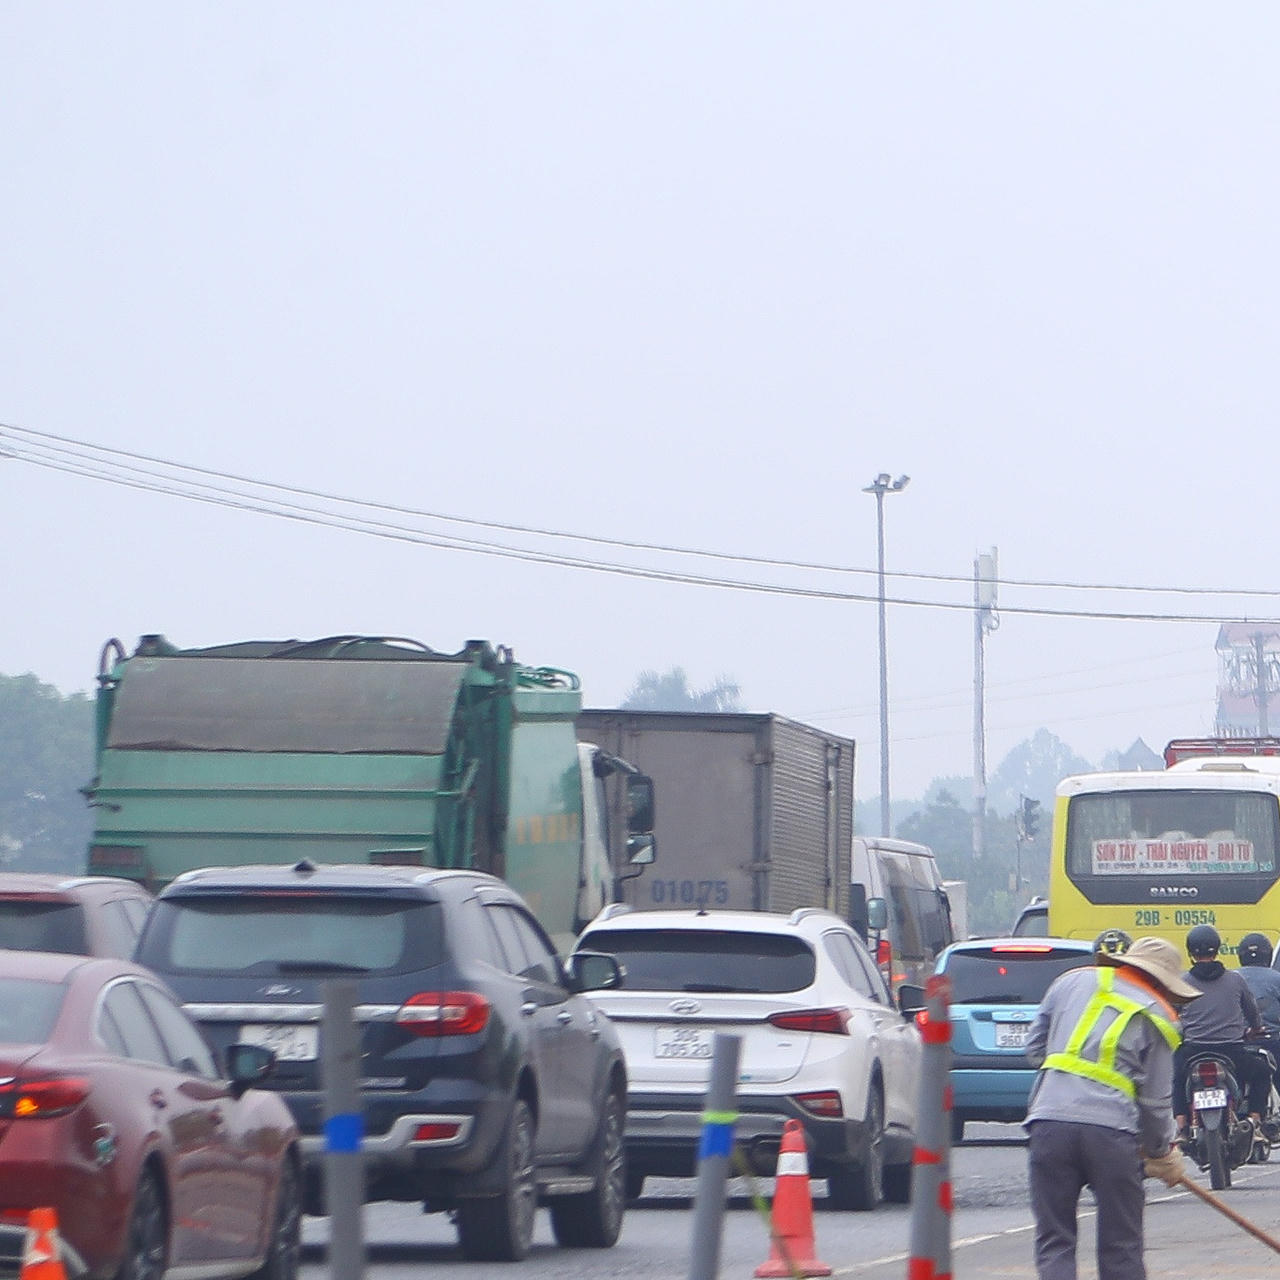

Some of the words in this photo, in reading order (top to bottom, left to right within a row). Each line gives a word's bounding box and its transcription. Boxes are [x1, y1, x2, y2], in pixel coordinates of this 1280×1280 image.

[1150, 887, 1199, 897] SAMCO
[1135, 910, 1160, 926] 29B
[1175, 910, 1216, 926] 09554
